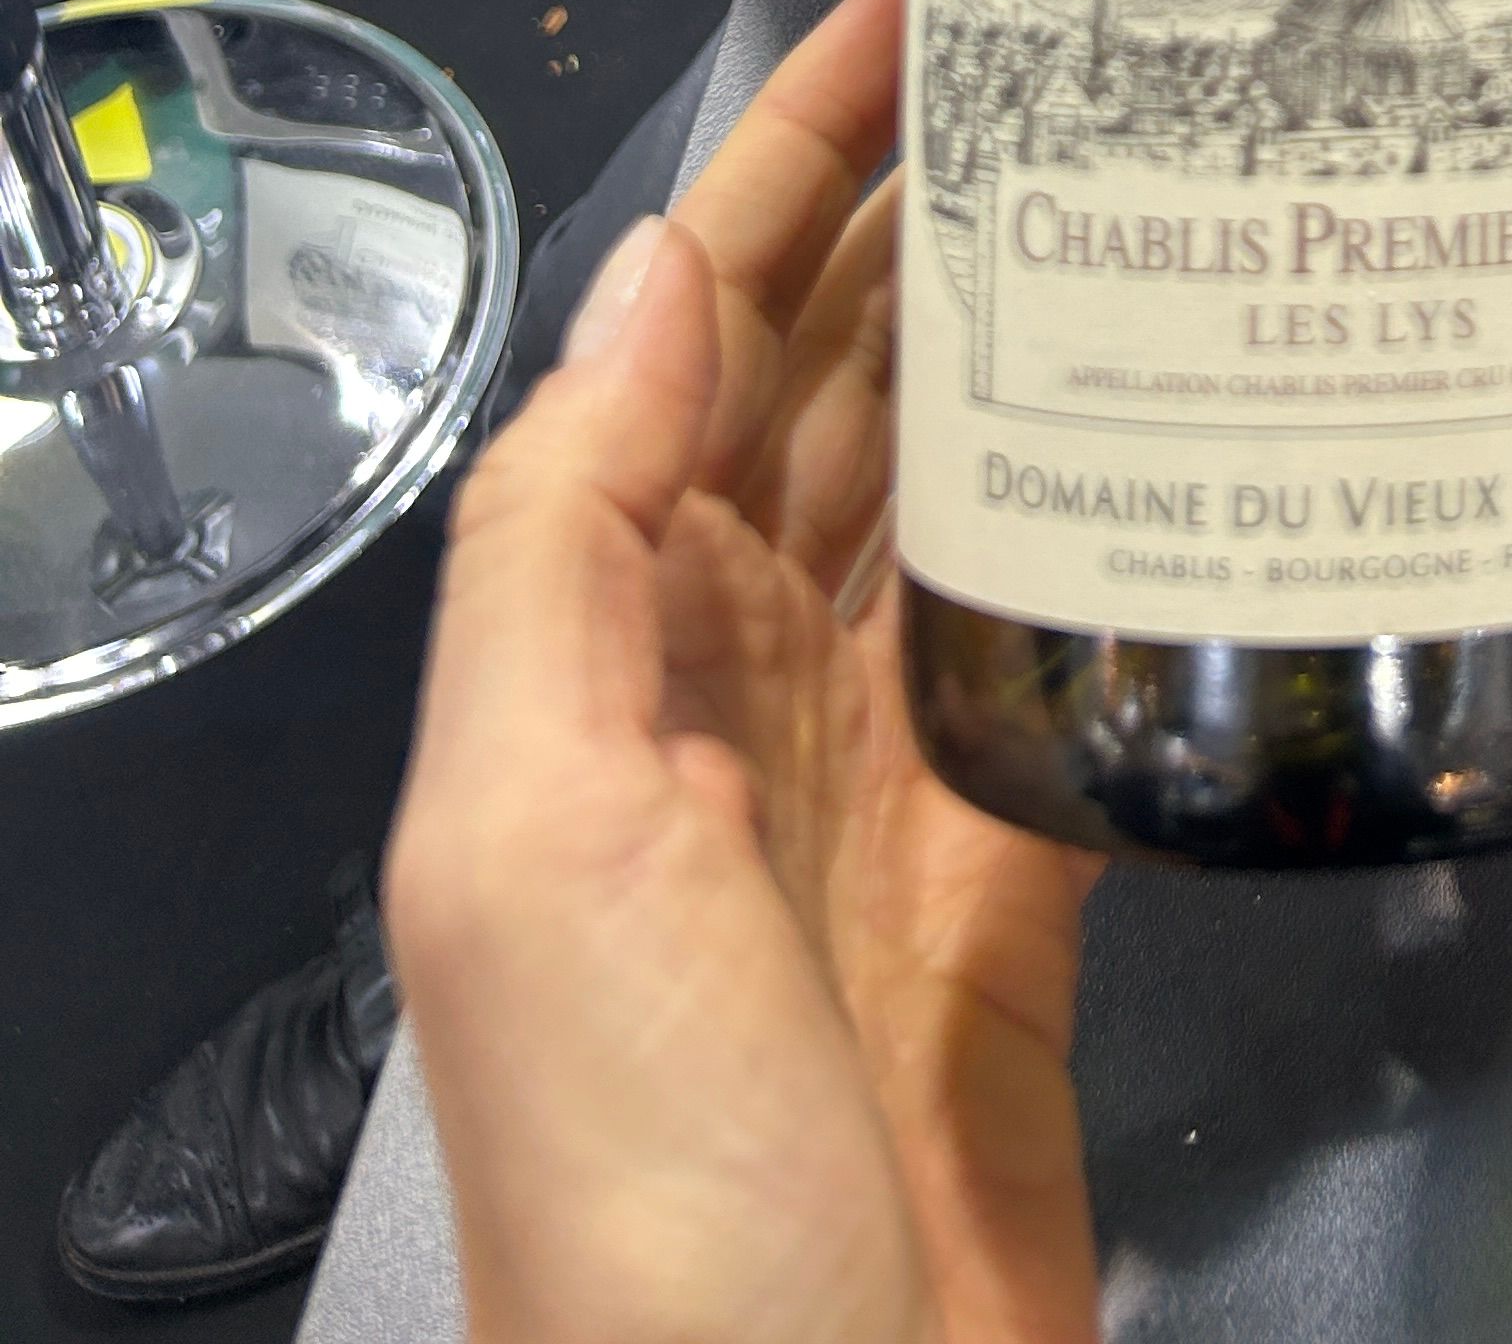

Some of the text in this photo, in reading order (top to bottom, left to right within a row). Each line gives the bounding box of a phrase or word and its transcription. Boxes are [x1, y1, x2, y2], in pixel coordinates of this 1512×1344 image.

[1014, 189, 1270, 275] CHABLIS
[1246, 297, 1478, 347] LES LYS
[1066, 365, 1221, 397] APPELLATION
[1226, 371, 1337, 399] CHABLIS
[1342, 368, 1452, 397] PREMIER
[1454, 364, 1507, 392] CRU
[984, 450, 1218, 528] DOMAINE
[1234, 483, 1312, 530] DU
[1340, 474, 1504, 529] VIEUX
[1108, 548, 1232, 582] CHABLIS
[1267, 549, 1473, 584] BOURGOGNE
